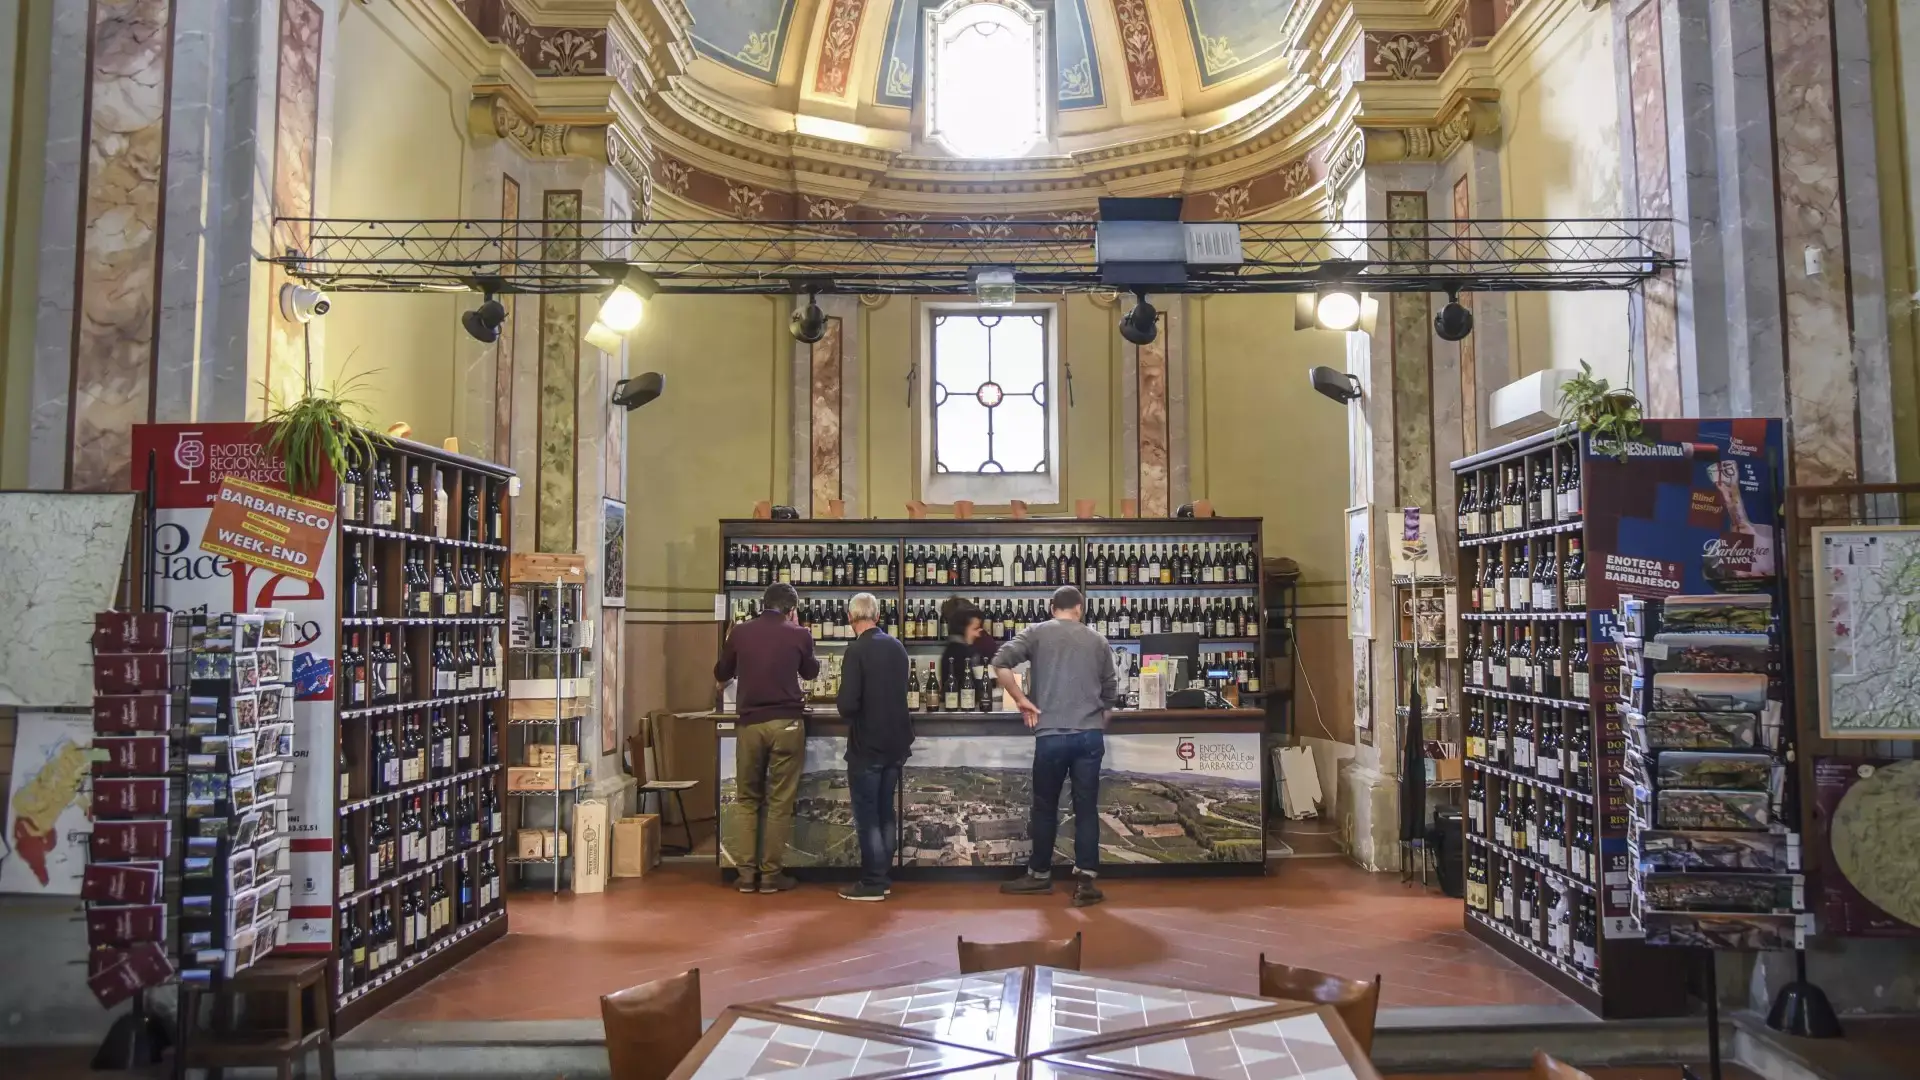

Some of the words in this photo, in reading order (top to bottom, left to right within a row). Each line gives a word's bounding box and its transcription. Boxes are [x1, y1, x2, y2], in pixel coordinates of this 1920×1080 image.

[210, 443, 265, 457] ENOTECA
[1657, 444, 1684, 457] TAVOLA
[210, 456, 278, 470] REGIONALE
[1692, 492, 1715, 503] Blind
[221, 488, 330, 530] BARBARESCO
[219, 528, 308, 565] WEEK-END
[1702, 539, 1769, 558] Barbaresco
[1606, 554, 1662, 571] ENOTECA
[1605, 564, 1647, 575] REGIONALE
[1605, 571, 1680, 589] BARBARESCO
[1600, 613, 1612, 625] IL
[1200, 744, 1235, 753] ENOTECA
[1200, 753, 1245, 761] REGIONALE
[1200, 761, 1254, 771] BARBARESCO
[1612, 856, 1627, 866] 13
